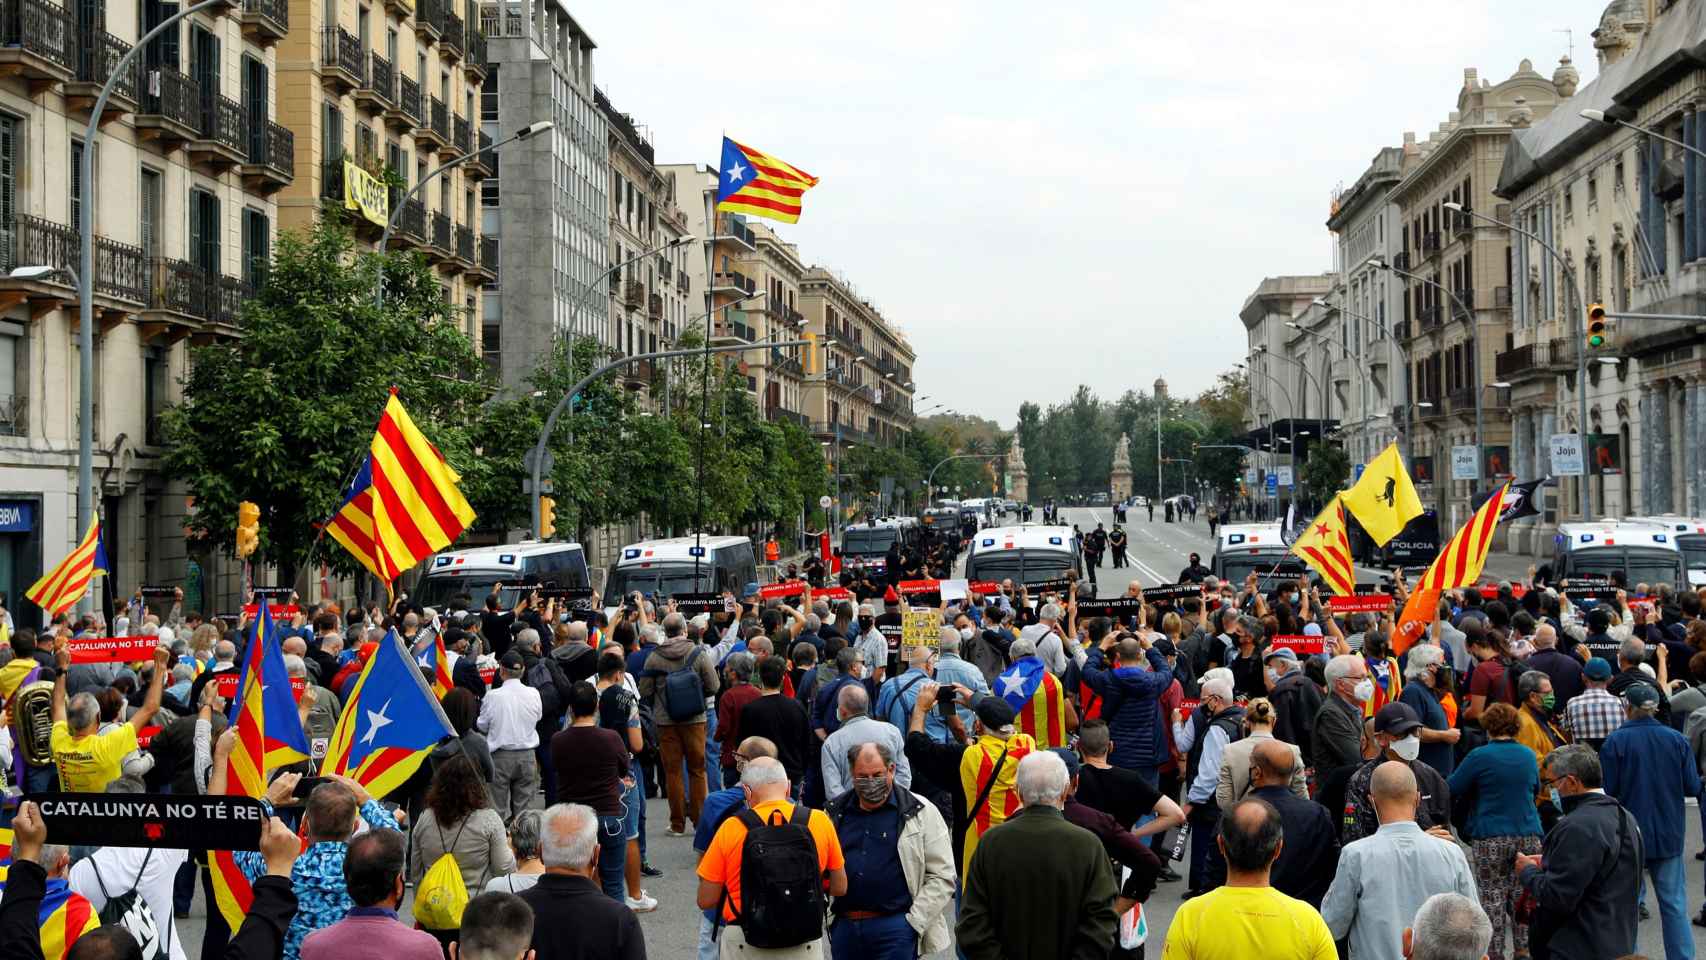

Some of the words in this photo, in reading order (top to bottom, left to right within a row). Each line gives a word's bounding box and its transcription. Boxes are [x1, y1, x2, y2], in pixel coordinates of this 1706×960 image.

[1557, 445, 1575, 457] Jojo
[1391, 541, 1434, 550] POLICIA
[69, 642, 117, 651] CATALUNYA
[134, 638, 144, 648] TÉ
[40, 801, 160, 818] CATALUNYA
[166, 803, 197, 818] NO
[202, 801, 228, 820] TÉ
